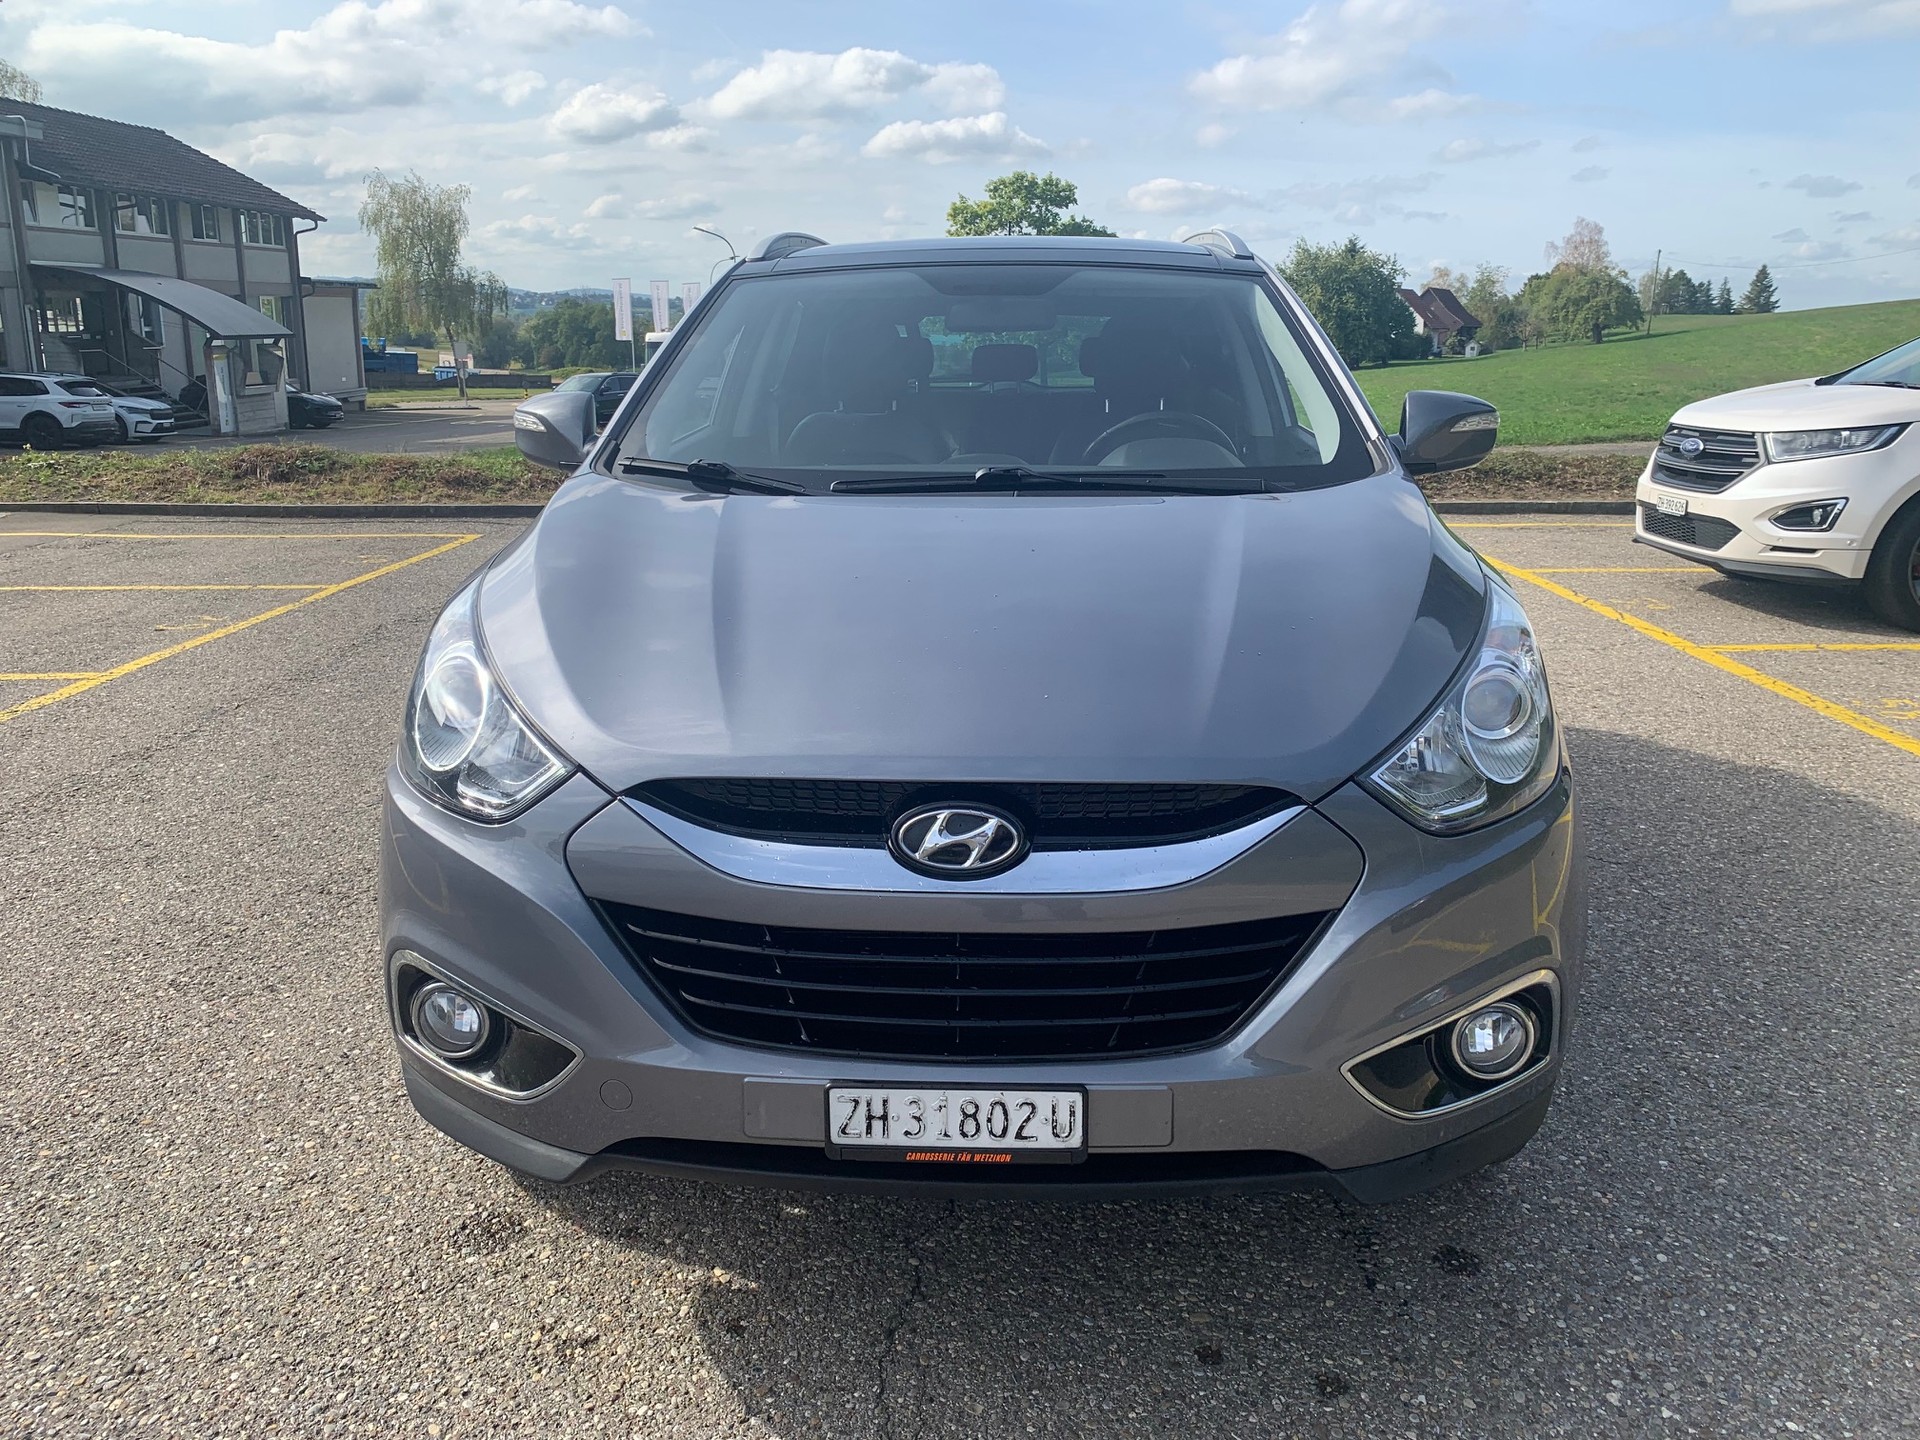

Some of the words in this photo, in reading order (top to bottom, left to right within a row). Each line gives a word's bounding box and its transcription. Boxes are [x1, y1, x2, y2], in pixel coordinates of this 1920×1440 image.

[837, 1094, 889, 1139] ZH
[902, 1094, 1038, 1142] 31802
[1051, 1097, 1076, 1142] U
[906, 1152, 955, 1161] CARROSSERIE
[974, 1153, 1012, 1162] WETZIKON
